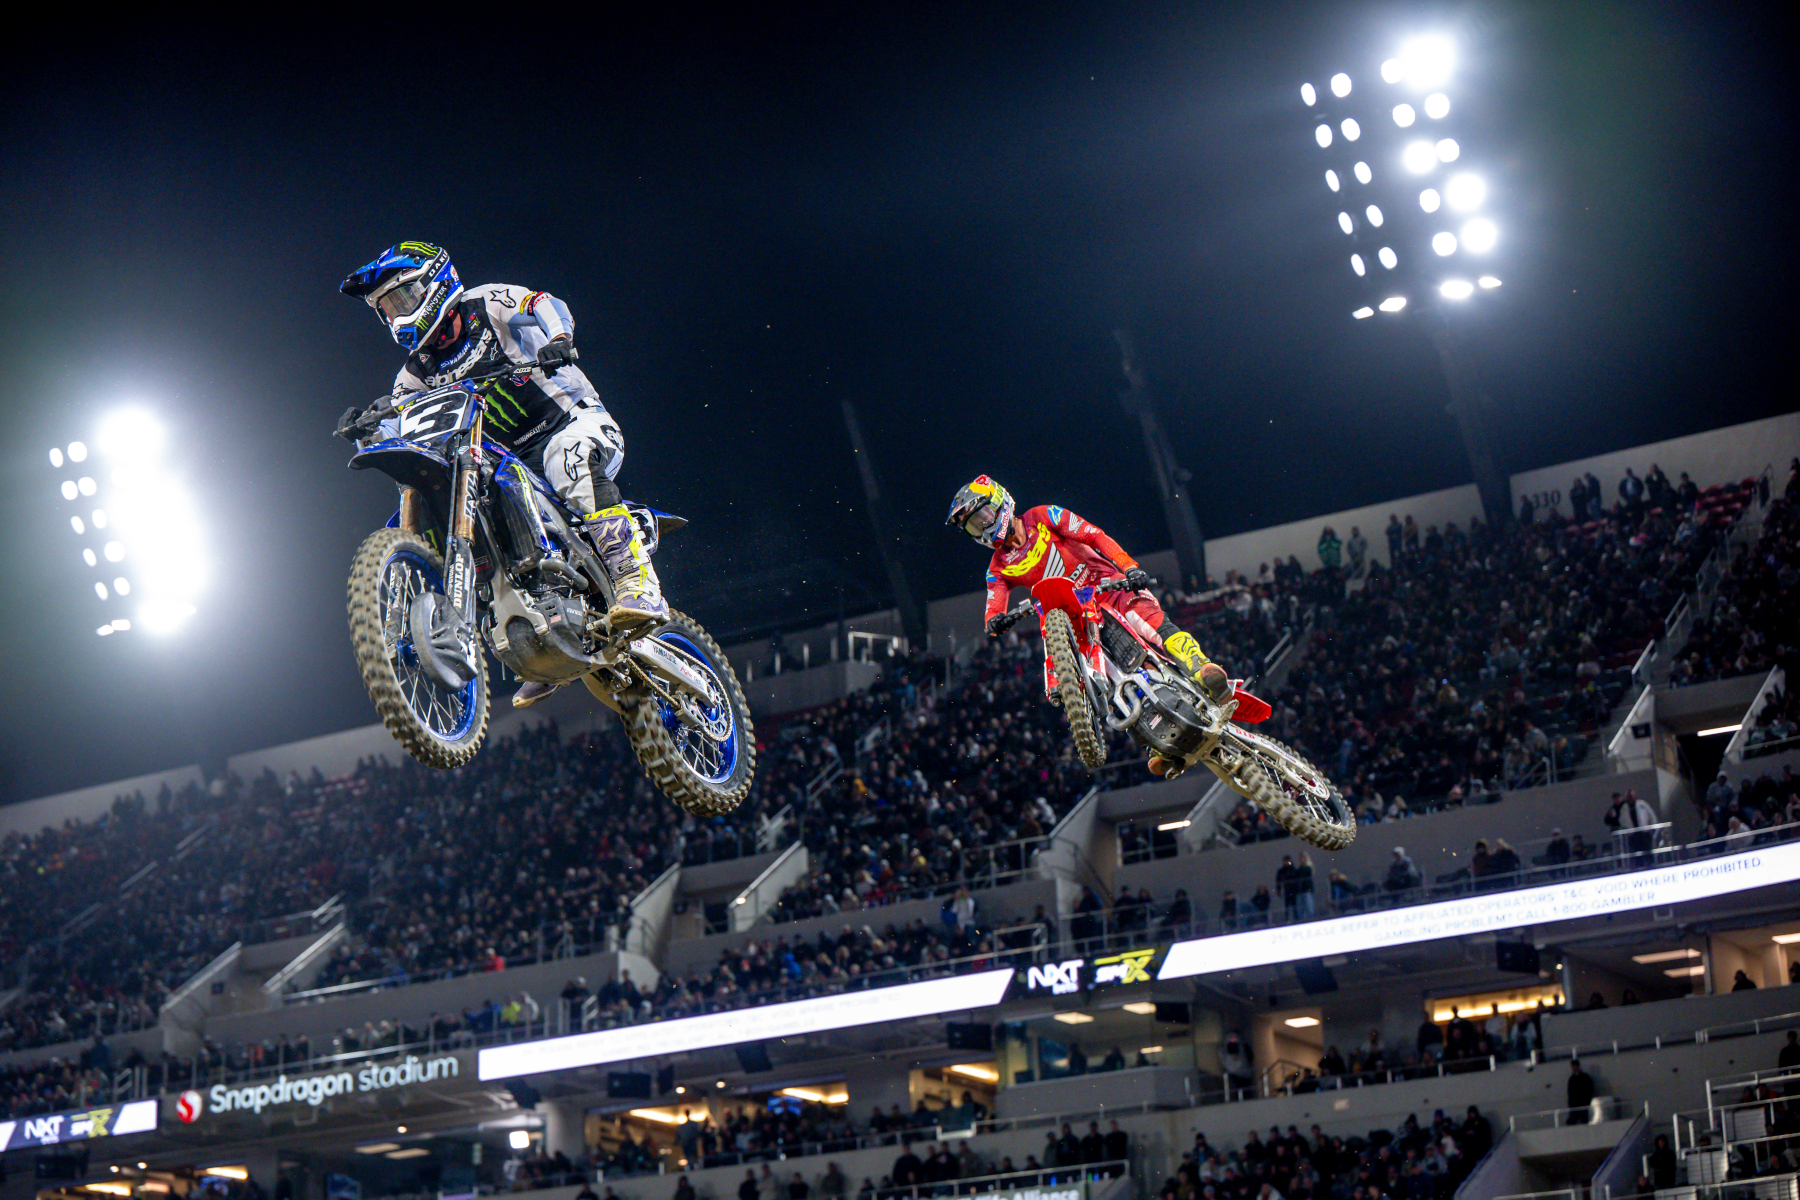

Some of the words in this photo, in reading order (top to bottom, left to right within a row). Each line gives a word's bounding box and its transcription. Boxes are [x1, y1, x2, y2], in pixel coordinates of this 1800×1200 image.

[453, 553, 465, 609] DUNLOP
[1292, 926, 1336, 941] PLEASE
[1341, 919, 1379, 933] REFER
[1384, 916, 1400, 927] TO
[1404, 904, 1474, 923] AFFILIATED
[1594, 881, 1628, 894] VOID
[1632, 872, 1679, 889] WHERE
[1374, 923, 1441, 942] GAMBLING
[1516, 908, 1549, 920] CALL
[1027, 959, 1084, 990] NXT
[209, 1074, 353, 1114] Snapdragon
[358, 1055, 459, 1092] stadium
[24, 1115, 64, 1140] NXT
